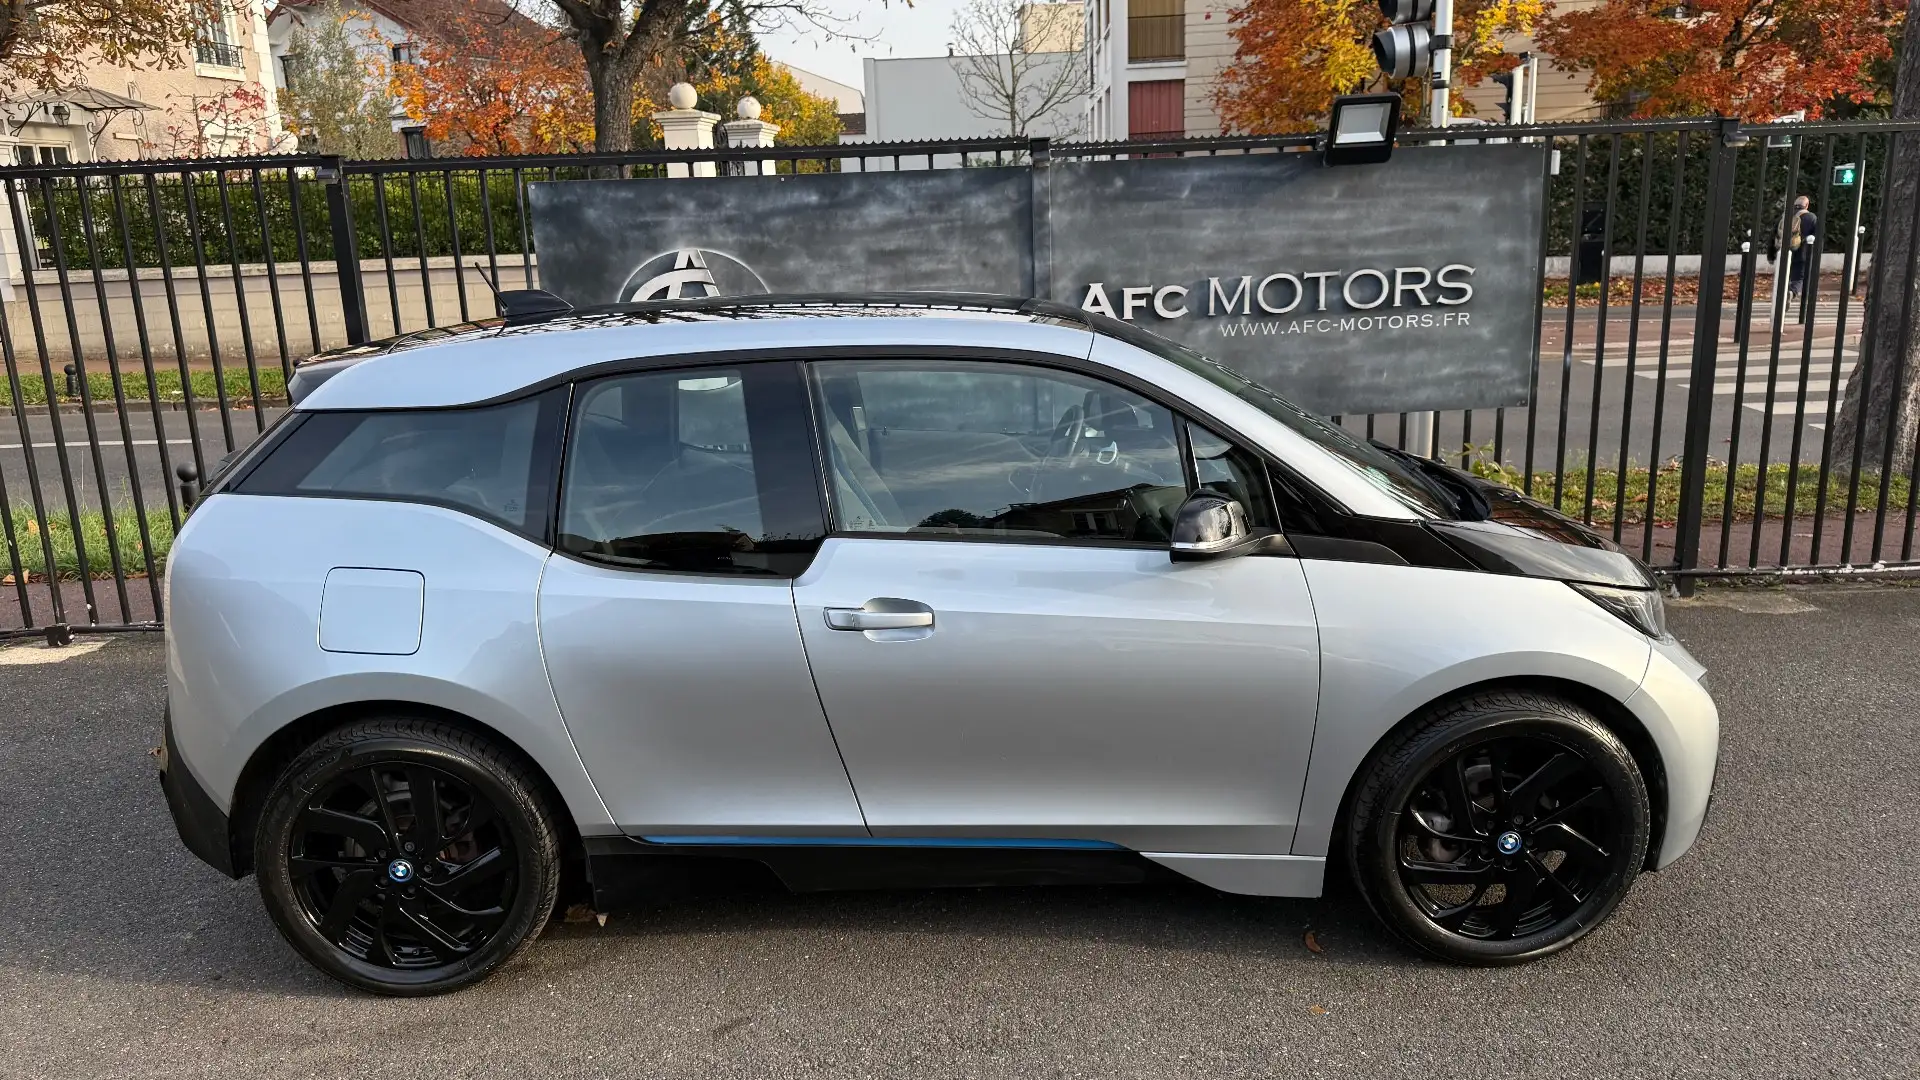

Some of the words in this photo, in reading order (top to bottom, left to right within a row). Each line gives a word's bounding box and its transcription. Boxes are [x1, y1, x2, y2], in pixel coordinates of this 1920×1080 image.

[1081, 282, 1190, 320] AFC
[1207, 263, 1477, 317] MOTORS
[1220, 311, 1471, 337] WWW.AFC-MOTORS.FR
